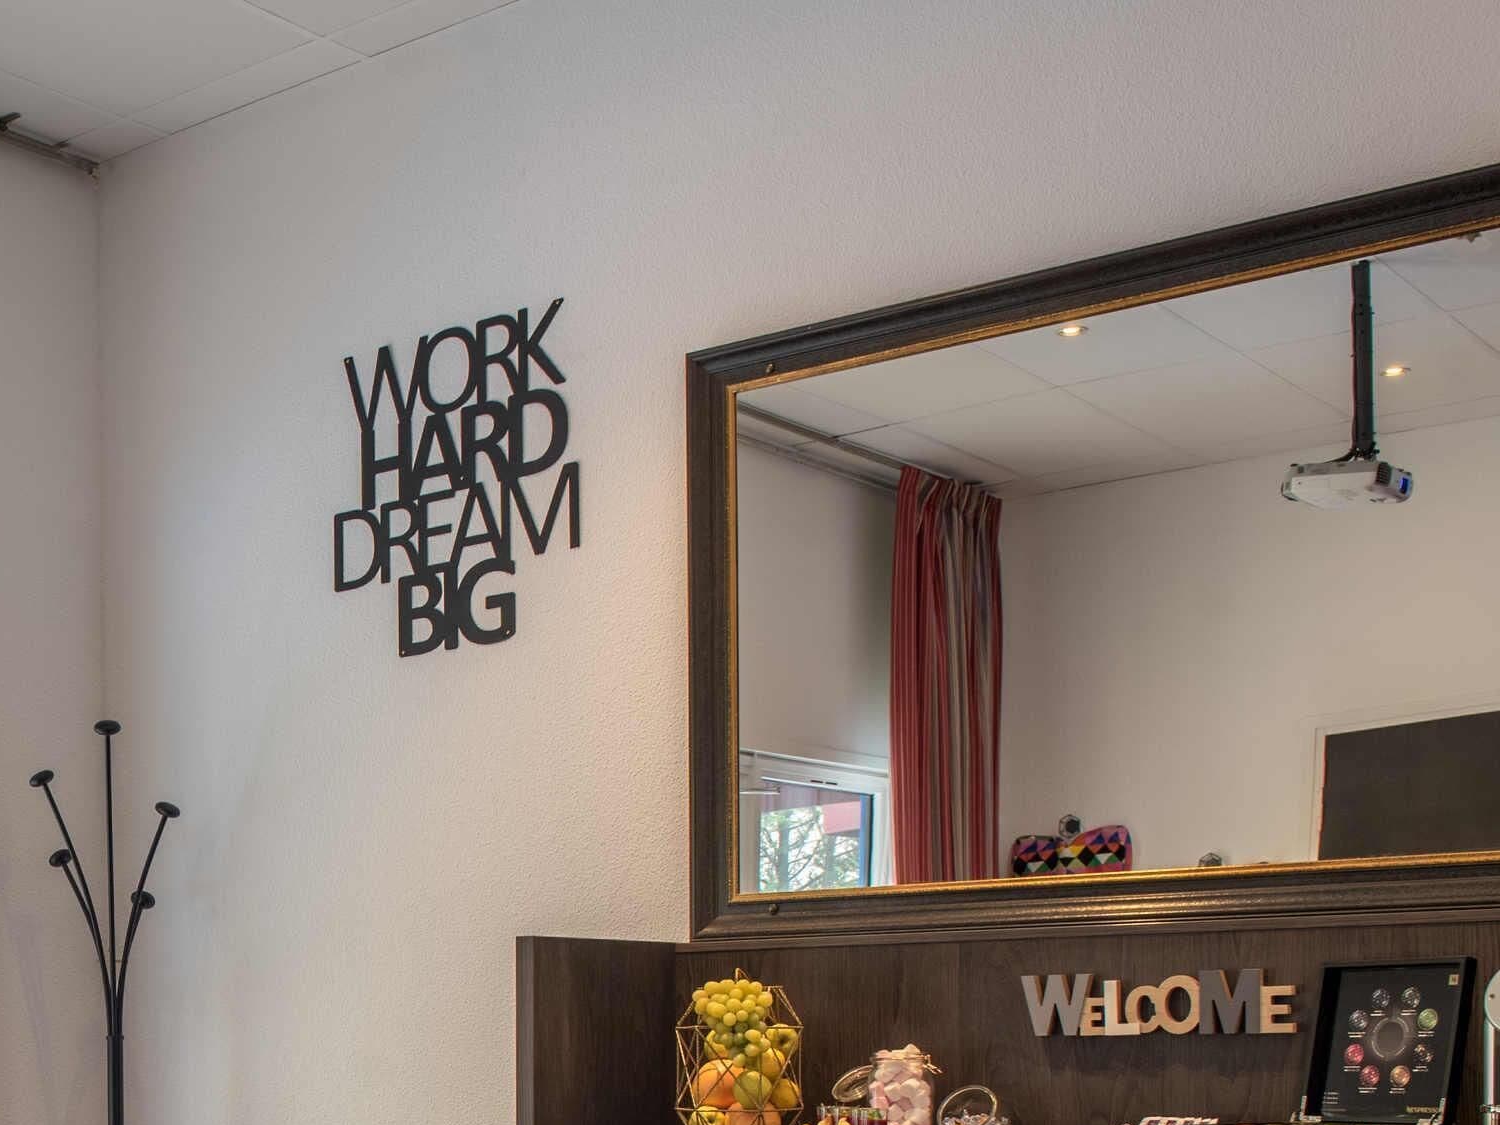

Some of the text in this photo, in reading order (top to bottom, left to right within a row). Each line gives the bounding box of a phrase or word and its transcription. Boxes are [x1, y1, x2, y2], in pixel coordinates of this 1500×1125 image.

[343, 297, 567, 430] WORK
[361, 388, 569, 511] HARD
[334, 461, 581, 592] DREAM
[398, 557, 516, 657] BIG
